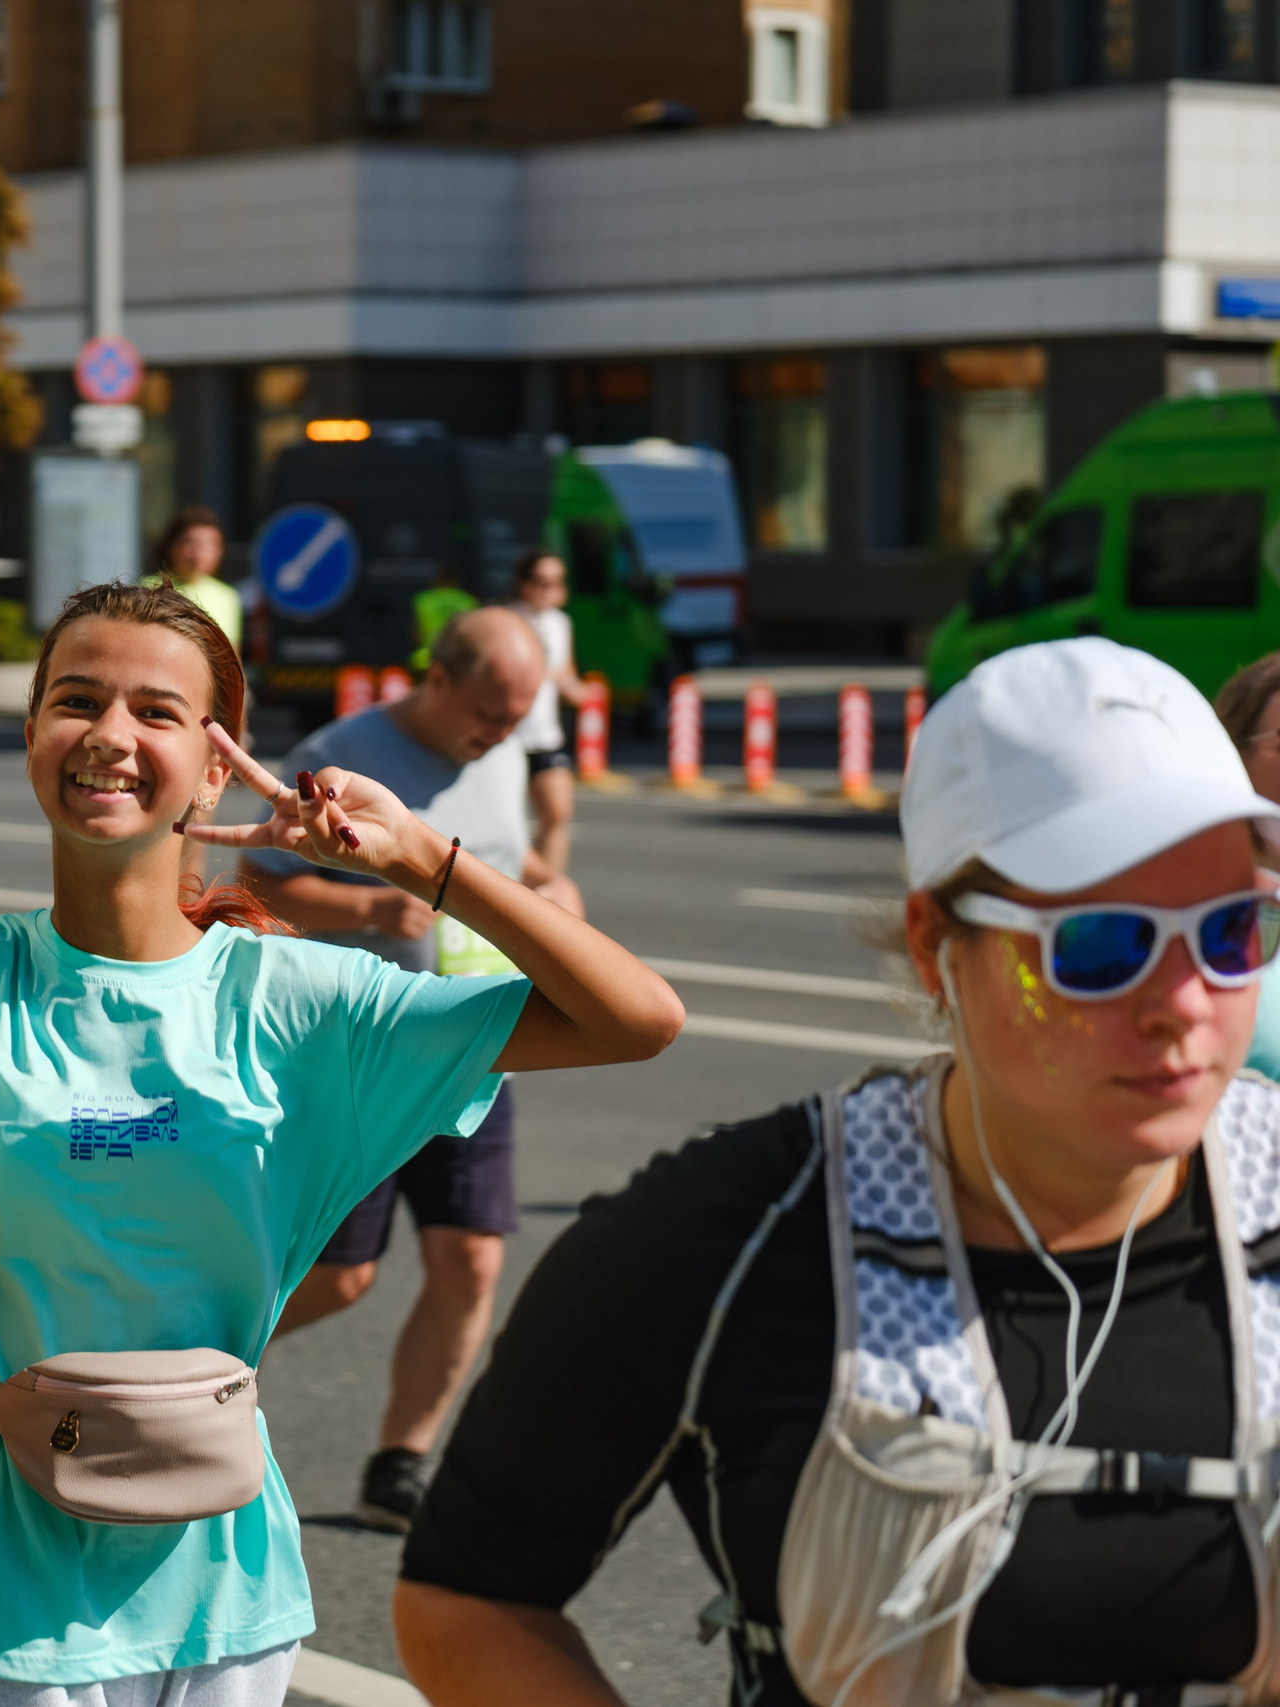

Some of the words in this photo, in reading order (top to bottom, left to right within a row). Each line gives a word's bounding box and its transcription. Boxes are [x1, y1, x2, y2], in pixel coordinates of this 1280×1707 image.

[73, 1091, 96, 1102] BIG
[71, 1100, 178, 1123] БОЛЬШОЙ
[70, 1123, 179, 1141] ФЕСТИВАЛЬ
[70, 1143, 133, 1161] БЕГА
